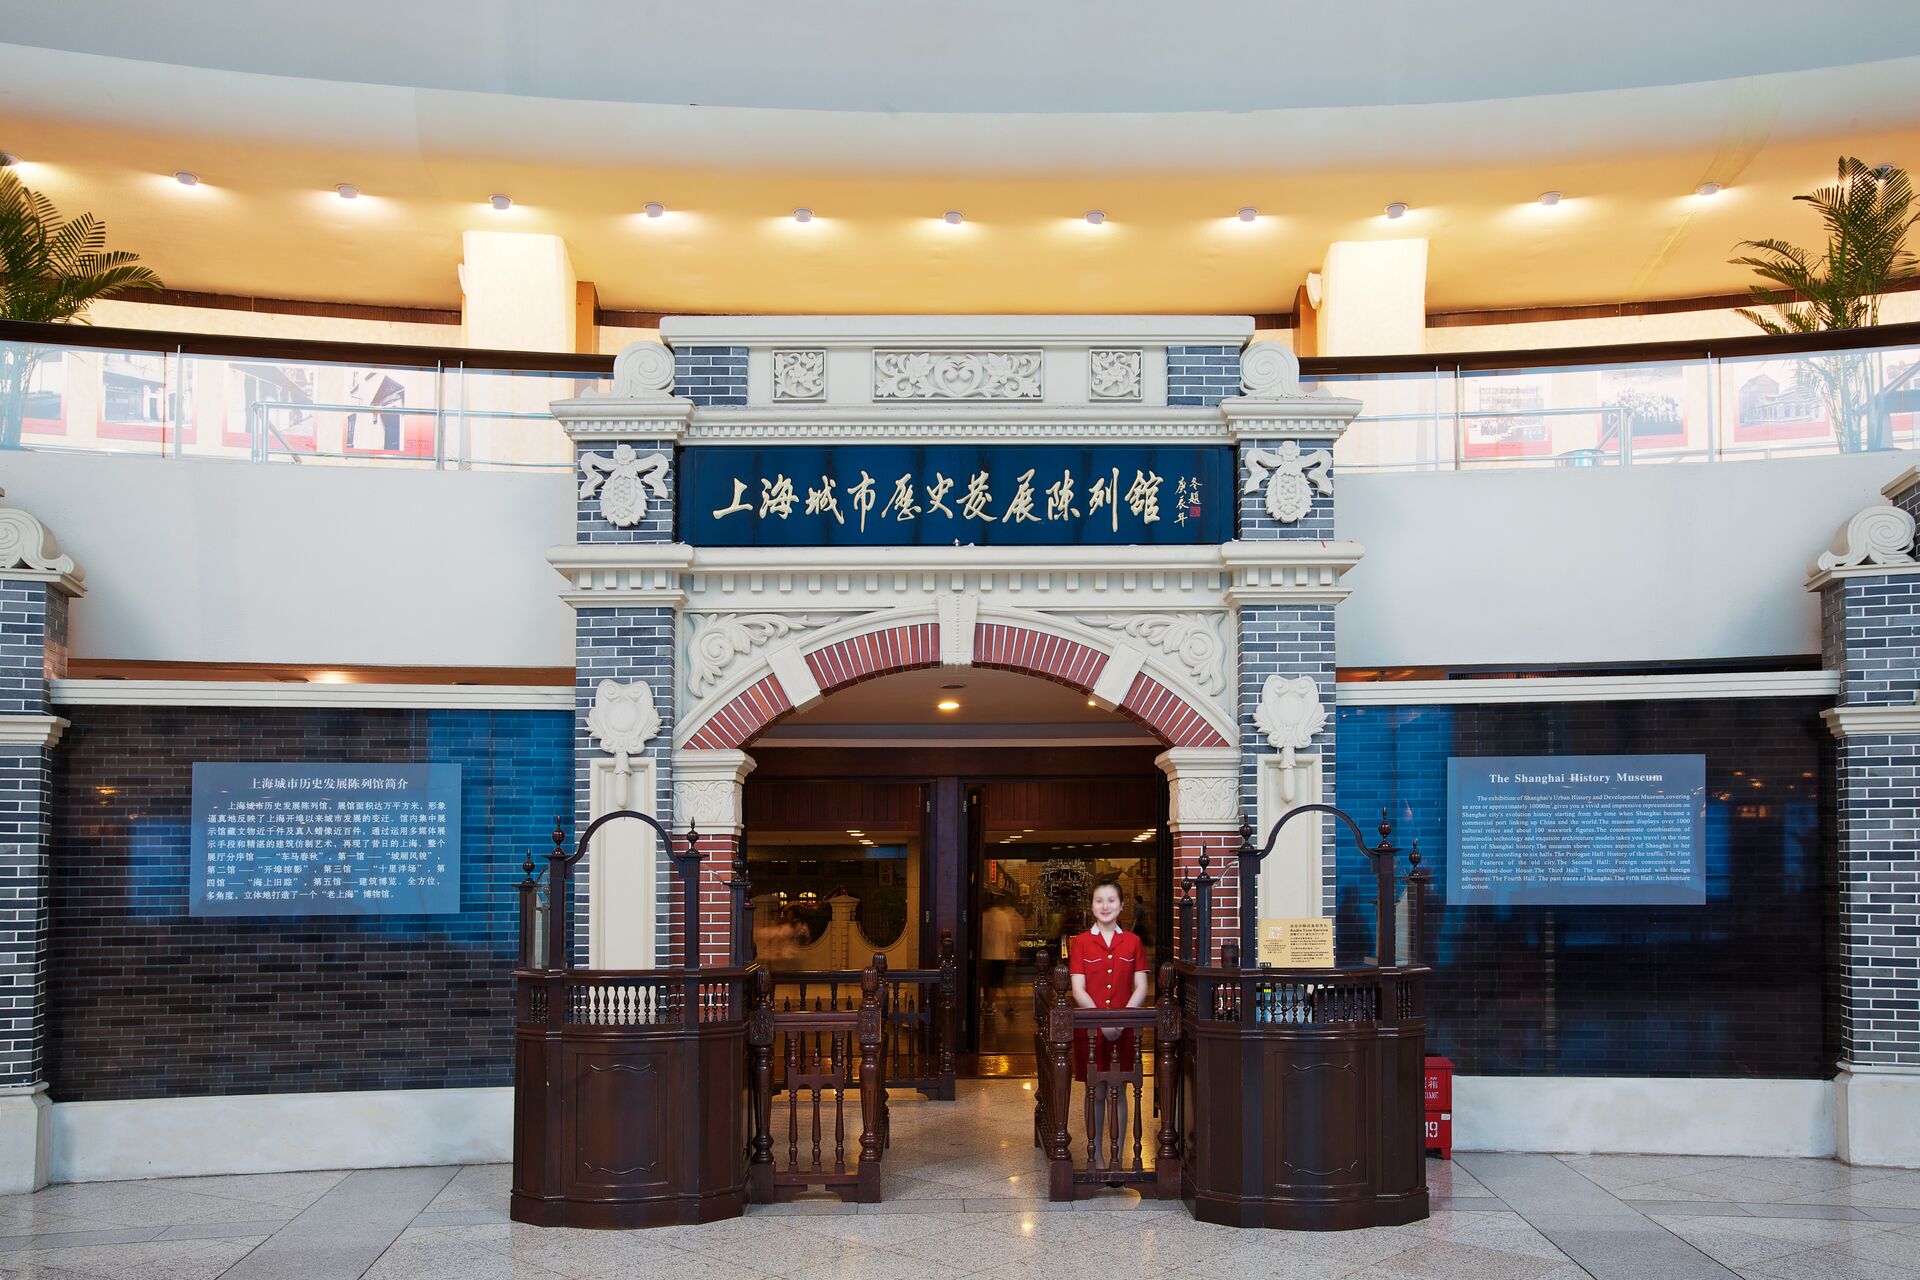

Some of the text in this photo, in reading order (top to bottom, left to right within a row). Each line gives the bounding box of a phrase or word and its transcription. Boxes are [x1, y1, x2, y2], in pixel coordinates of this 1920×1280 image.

[249, 777, 409, 790] 上海城市历史发展陈列馆简介
[1489, 772, 1663, 785] The Shanghai History Museum
[1424, 1076, 1438, 1089] 箱
